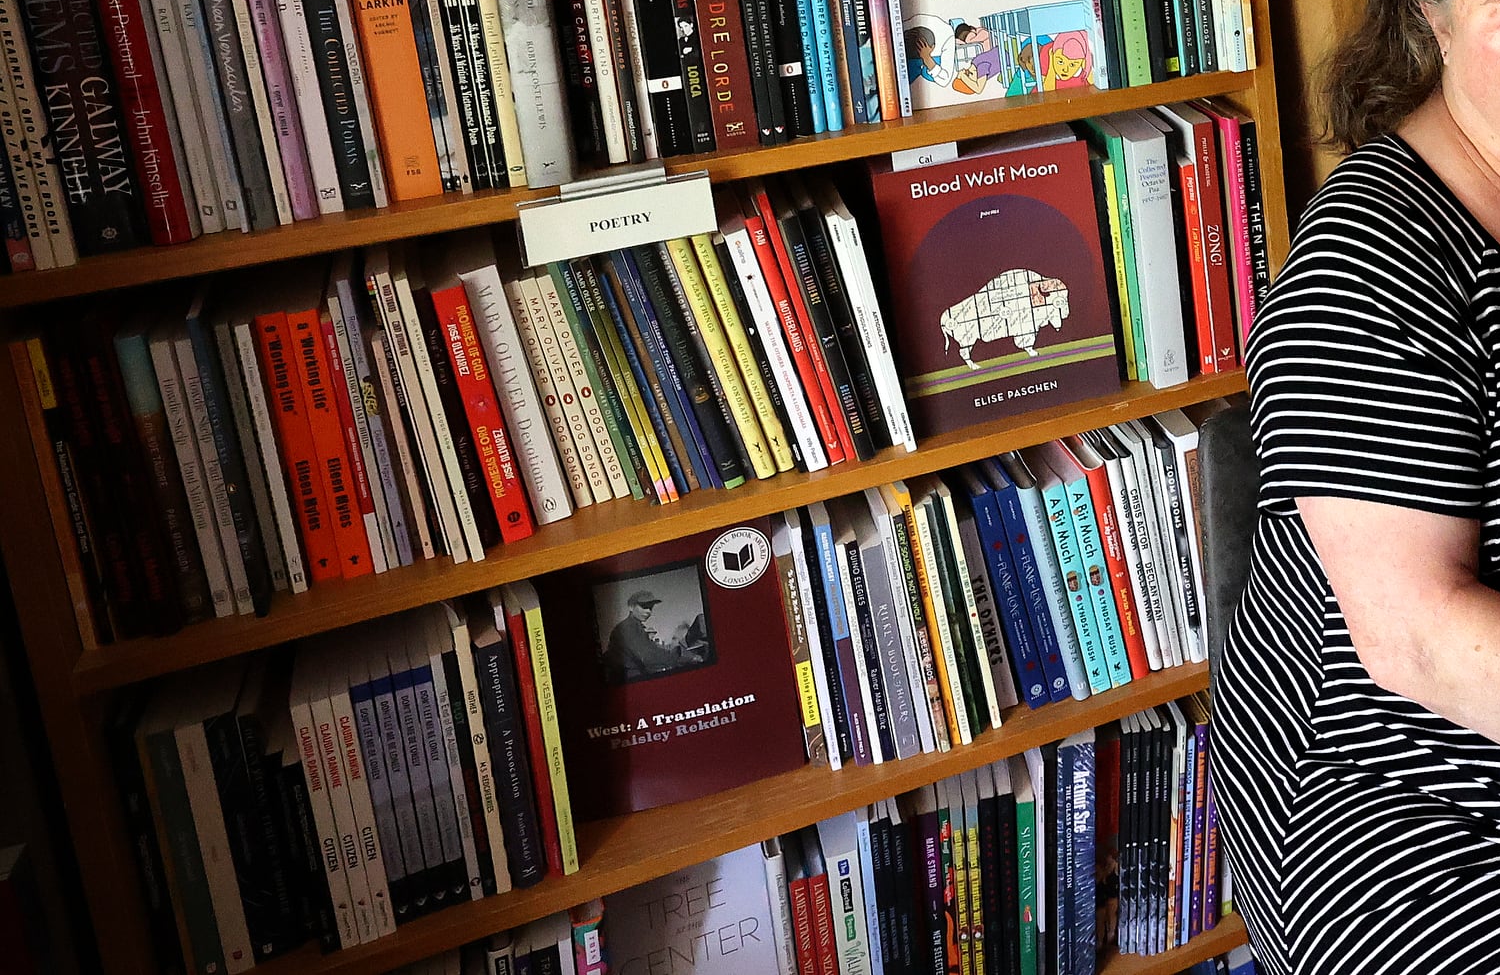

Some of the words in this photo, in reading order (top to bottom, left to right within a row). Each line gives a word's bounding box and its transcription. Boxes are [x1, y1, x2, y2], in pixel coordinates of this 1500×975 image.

[575, 16, 593, 85] CARRYING
[687, 65, 702, 98] LORCA
[709, 49, 734, 114] LORDE
[45, 83, 94, 204] KINNELL
[79, 76, 132, 197] GALWAY
[133, 109, 153, 145] John
[142, 149, 169, 208] Kinsella
[918, 155, 933, 164] Cal
[910, 176, 961, 199] Blood
[964, 167, 1005, 189] Wolf
[1010, 161, 1059, 178] Moon
[589, 212, 652, 233] POETRY
[979, 208, 1000, 219] poems
[1250, 203, 1263, 243] THEN
[755, 229, 765, 246] PAN
[1207, 224, 1222, 266] ZONG!
[1254, 245, 1266, 283] THE
[547, 291, 565, 327] MARY
[561, 331, 584, 377] OLIVER
[779, 299, 803, 353] MOTHERLANDS
[452, 342, 470, 377] OLIVAREZ
[476, 285, 501, 336] MARY
[496, 342, 526, 412] OLIVER
[517, 419, 546, 493] Devotions
[974, 392, 1004, 407] ELISE
[1007, 380, 1058, 399] PASCHEN
[589, 408, 605, 434] DOG
[600, 437, 621, 481] SONGS
[1073, 493, 1084, 503] A
[1166, 464, 1177, 494] ZOOM
[1076, 503, 1088, 521] Bit
[1130, 489, 1143, 520] CRISIS
[1170, 496, 1182, 529] ROOMS
[710, 537, 732, 573] NATIONAL
[731, 531, 751, 540] BOOK
[753, 536, 766, 561] AWARD
[1080, 524, 1098, 559] Much
[1135, 521, 1148, 551] ACTOR
[722, 566, 760, 584] LONGLIST
[1144, 562, 1157, 593] DECLAN
[1152, 595, 1162, 621] RYAN
[1099, 596, 1114, 631] LYNDSAY
[1108, 633, 1118, 657] RUSH
[489, 655, 506, 713] Appropriate
[533, 627, 551, 680] IMAGINARY
[542, 681, 555, 723] VESSELS
[586, 722, 633, 739] West:
[636, 718, 649, 730] A
[652, 692, 756, 726] Translation
[611, 729, 672, 750] Paisley
[676, 712, 737, 736] Rekdal
[553, 746, 561, 776] REKDAL
[1073, 771, 1090, 807] Arthur
[1074, 806, 1086, 833] Sze
[362, 826, 377, 861] CITIZEN
[638, 878, 725, 926] TREE
